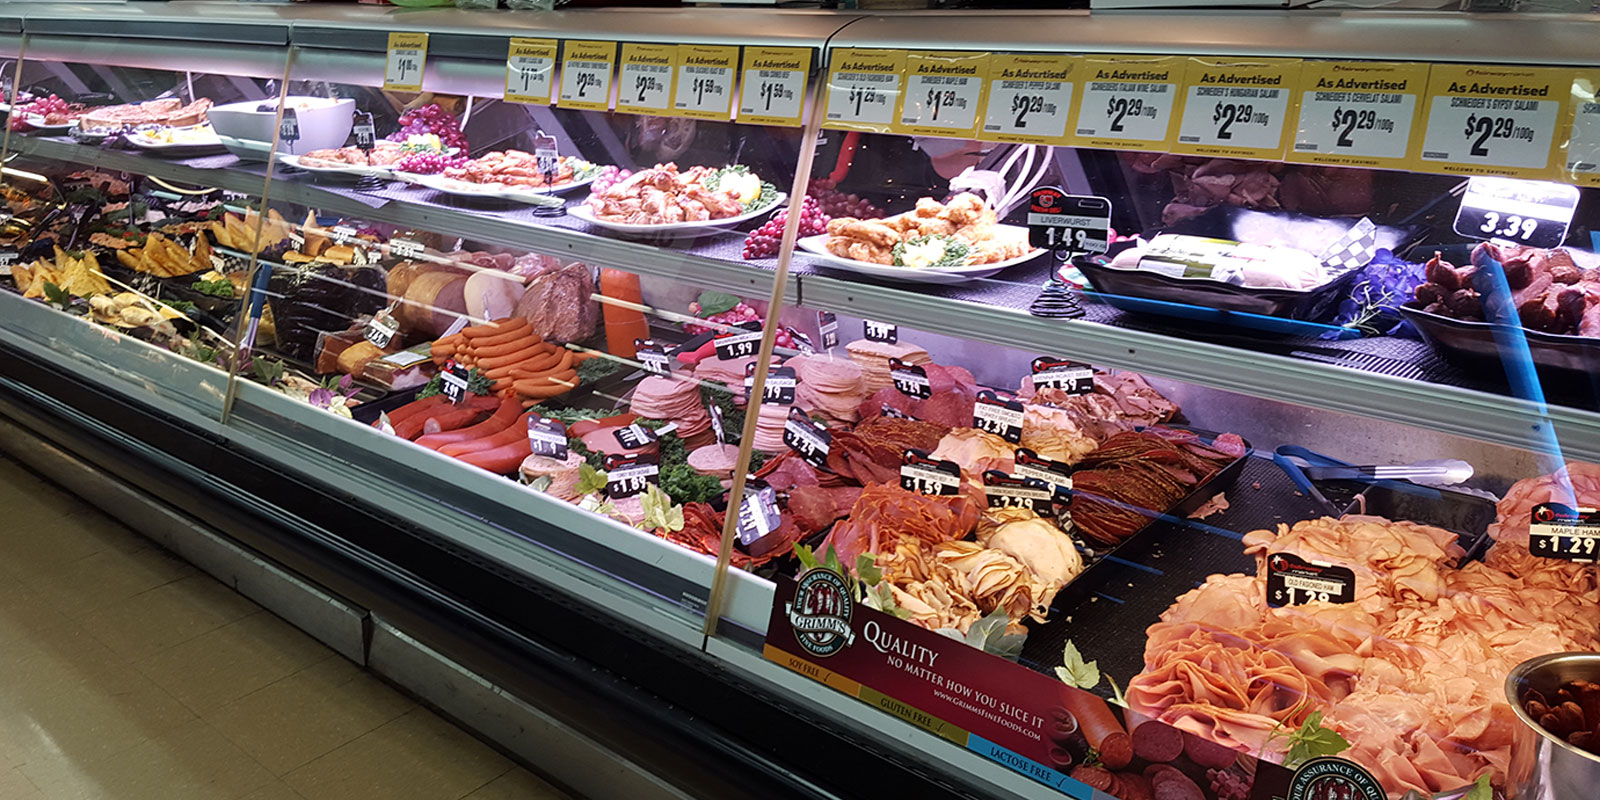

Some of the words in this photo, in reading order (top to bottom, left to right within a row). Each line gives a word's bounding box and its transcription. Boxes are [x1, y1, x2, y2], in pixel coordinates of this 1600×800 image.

[638, 55, 669, 64] Advertised
[686, 56, 694, 64] As
[695, 57, 729, 65] Advertised
[752, 60, 762, 68] As
[763, 60, 800, 69] Advertised
[841, 62, 851, 70] As
[852, 62, 895, 71] Advertised
[918, 64, 928, 73] As
[930, 65, 977, 74] Advertised
[1002, 69, 1014, 77] As
[1016, 69, 1067, 79] Advertised
[1096, 70, 1110, 79] As
[1110, 70, 1169, 80] Advertised
[1200, 73, 1216, 83] As
[1217, 74, 1282, 85] Advertised
[1150, 84, 1168, 93] SALAMI
[1317, 78, 1334, 88] As
[1336, 78, 1407, 90] Advertised
[1448, 82, 1466, 93] As
[1469, 83, 1550, 97] Advertised
[1230, 88, 1259, 98] HUNGARIAN
[1259, 89, 1280, 99] SALAMI
[1352, 93, 1379, 103] CERVELAT
[1380, 94, 1403, 104] SALAMI
[1492, 99, 1512, 110] GYPSY
[1514, 100, 1539, 111] SALAMI
[1041, 217, 1091, 226] LIVERWURST
[1480, 211, 1538, 240] 3.39
[727, 342, 752, 356] 1.99
[1001, 410, 1021, 419] SMOKED
[1021, 467, 1043, 478] PEPPER
[1044, 473, 1066, 485] SALAMI
[1290, 564, 1323, 573] fairway
[1288, 578, 1299, 587] OLD
[1324, 584, 1336, 592] HAM
[802, 572, 832, 590] ASSURANCE
[840, 584, 849, 619] QUALITY
[795, 616, 846, 635] GRIMM'S
[800, 634, 812, 650] FINE
[812, 645, 833, 653] FOODS
[864, 620, 940, 668] QUALITY
[789, 658, 804, 670] SOY
[803, 664, 820, 677] FREE
[887, 655, 903, 669] NO
[905, 663, 944, 686] MATTER
[946, 679, 973, 698] HOW
[975, 689, 998, 708] YOU
[999, 700, 1029, 725] SLICE
[1031, 714, 1045, 730] IT
[880, 698, 912, 719] GLUTEN
[913, 710, 932, 728] FREE
[989, 747, 1028, 772] LACTOSE
[1027, 762, 1052, 784] FREE
[1293, 784, 1304, 800] OUR
[1301, 764, 1353, 783] ASSURANCE
[1354, 773, 1367, 785] OF
